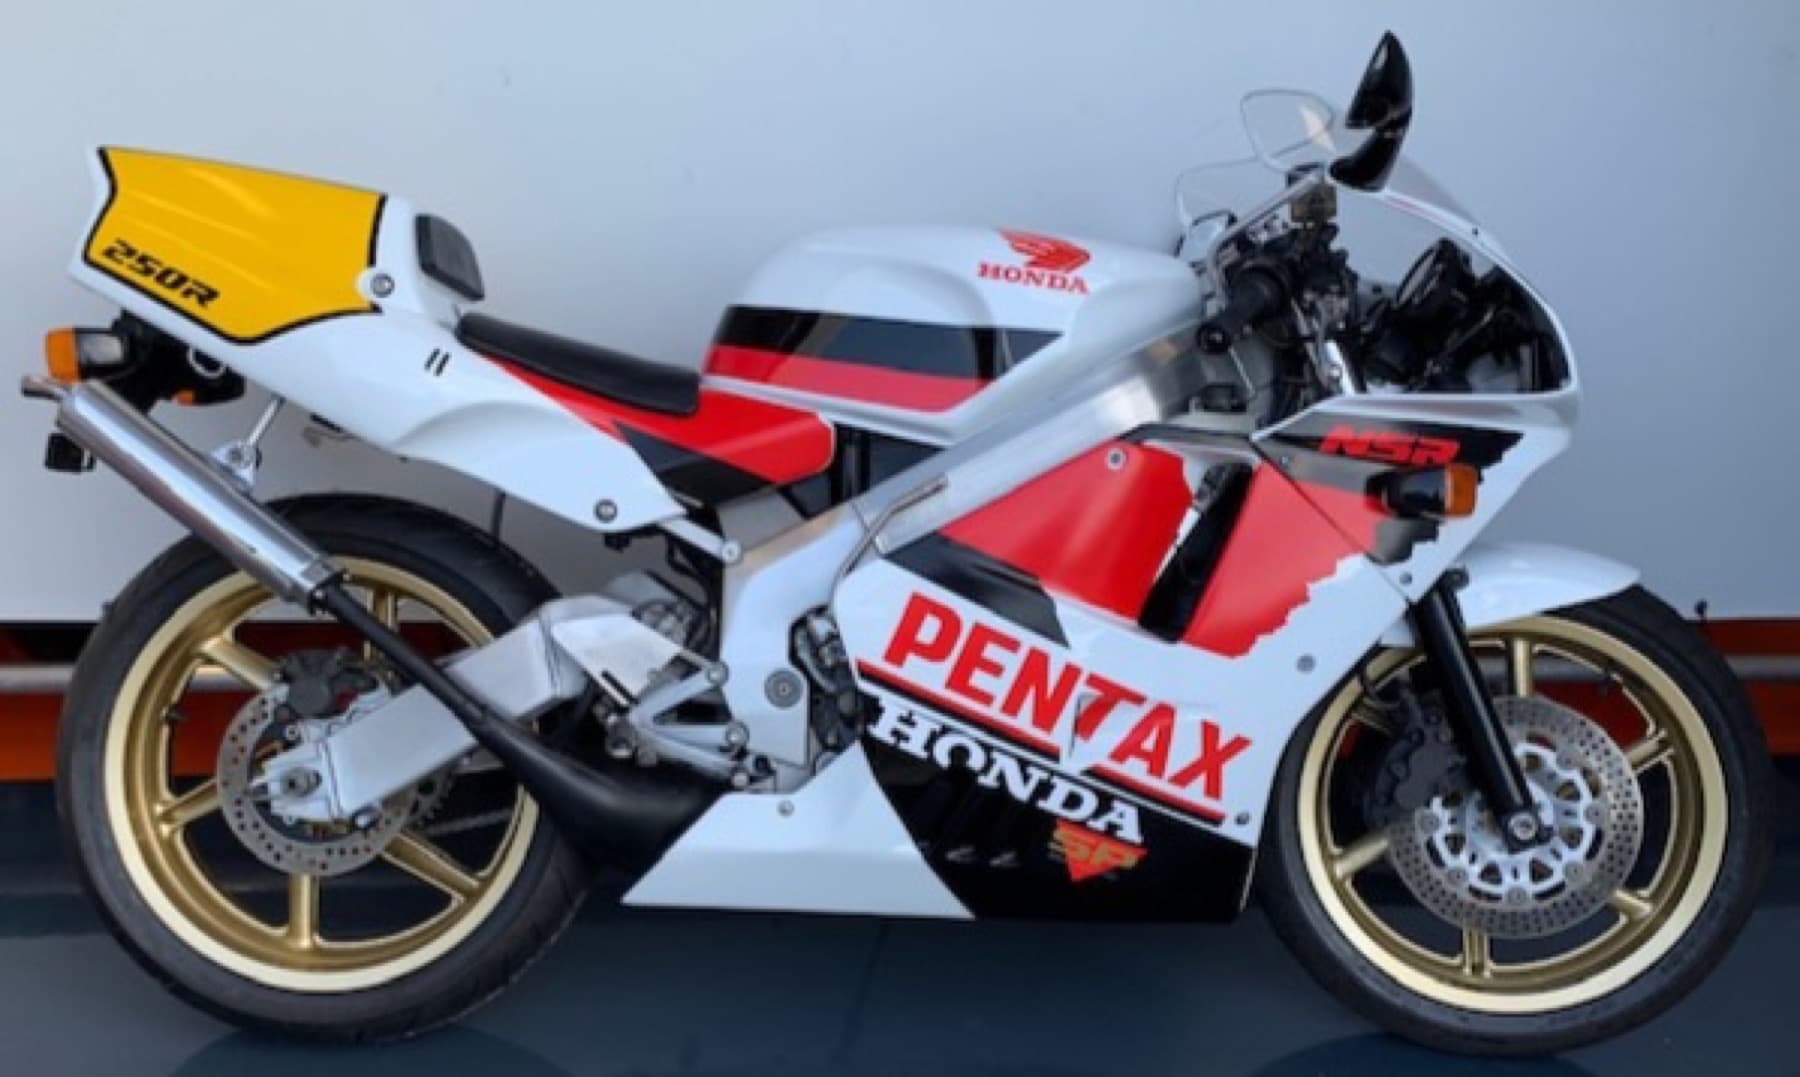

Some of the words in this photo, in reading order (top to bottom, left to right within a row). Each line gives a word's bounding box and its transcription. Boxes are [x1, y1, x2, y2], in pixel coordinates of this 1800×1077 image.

[103, 238, 220, 307] 250R
[978, 263, 1089, 295] HONDA
[1318, 426, 1460, 465] NSR
[882, 592, 1251, 800] PENTAX
[867, 692, 1144, 844] HONDA
